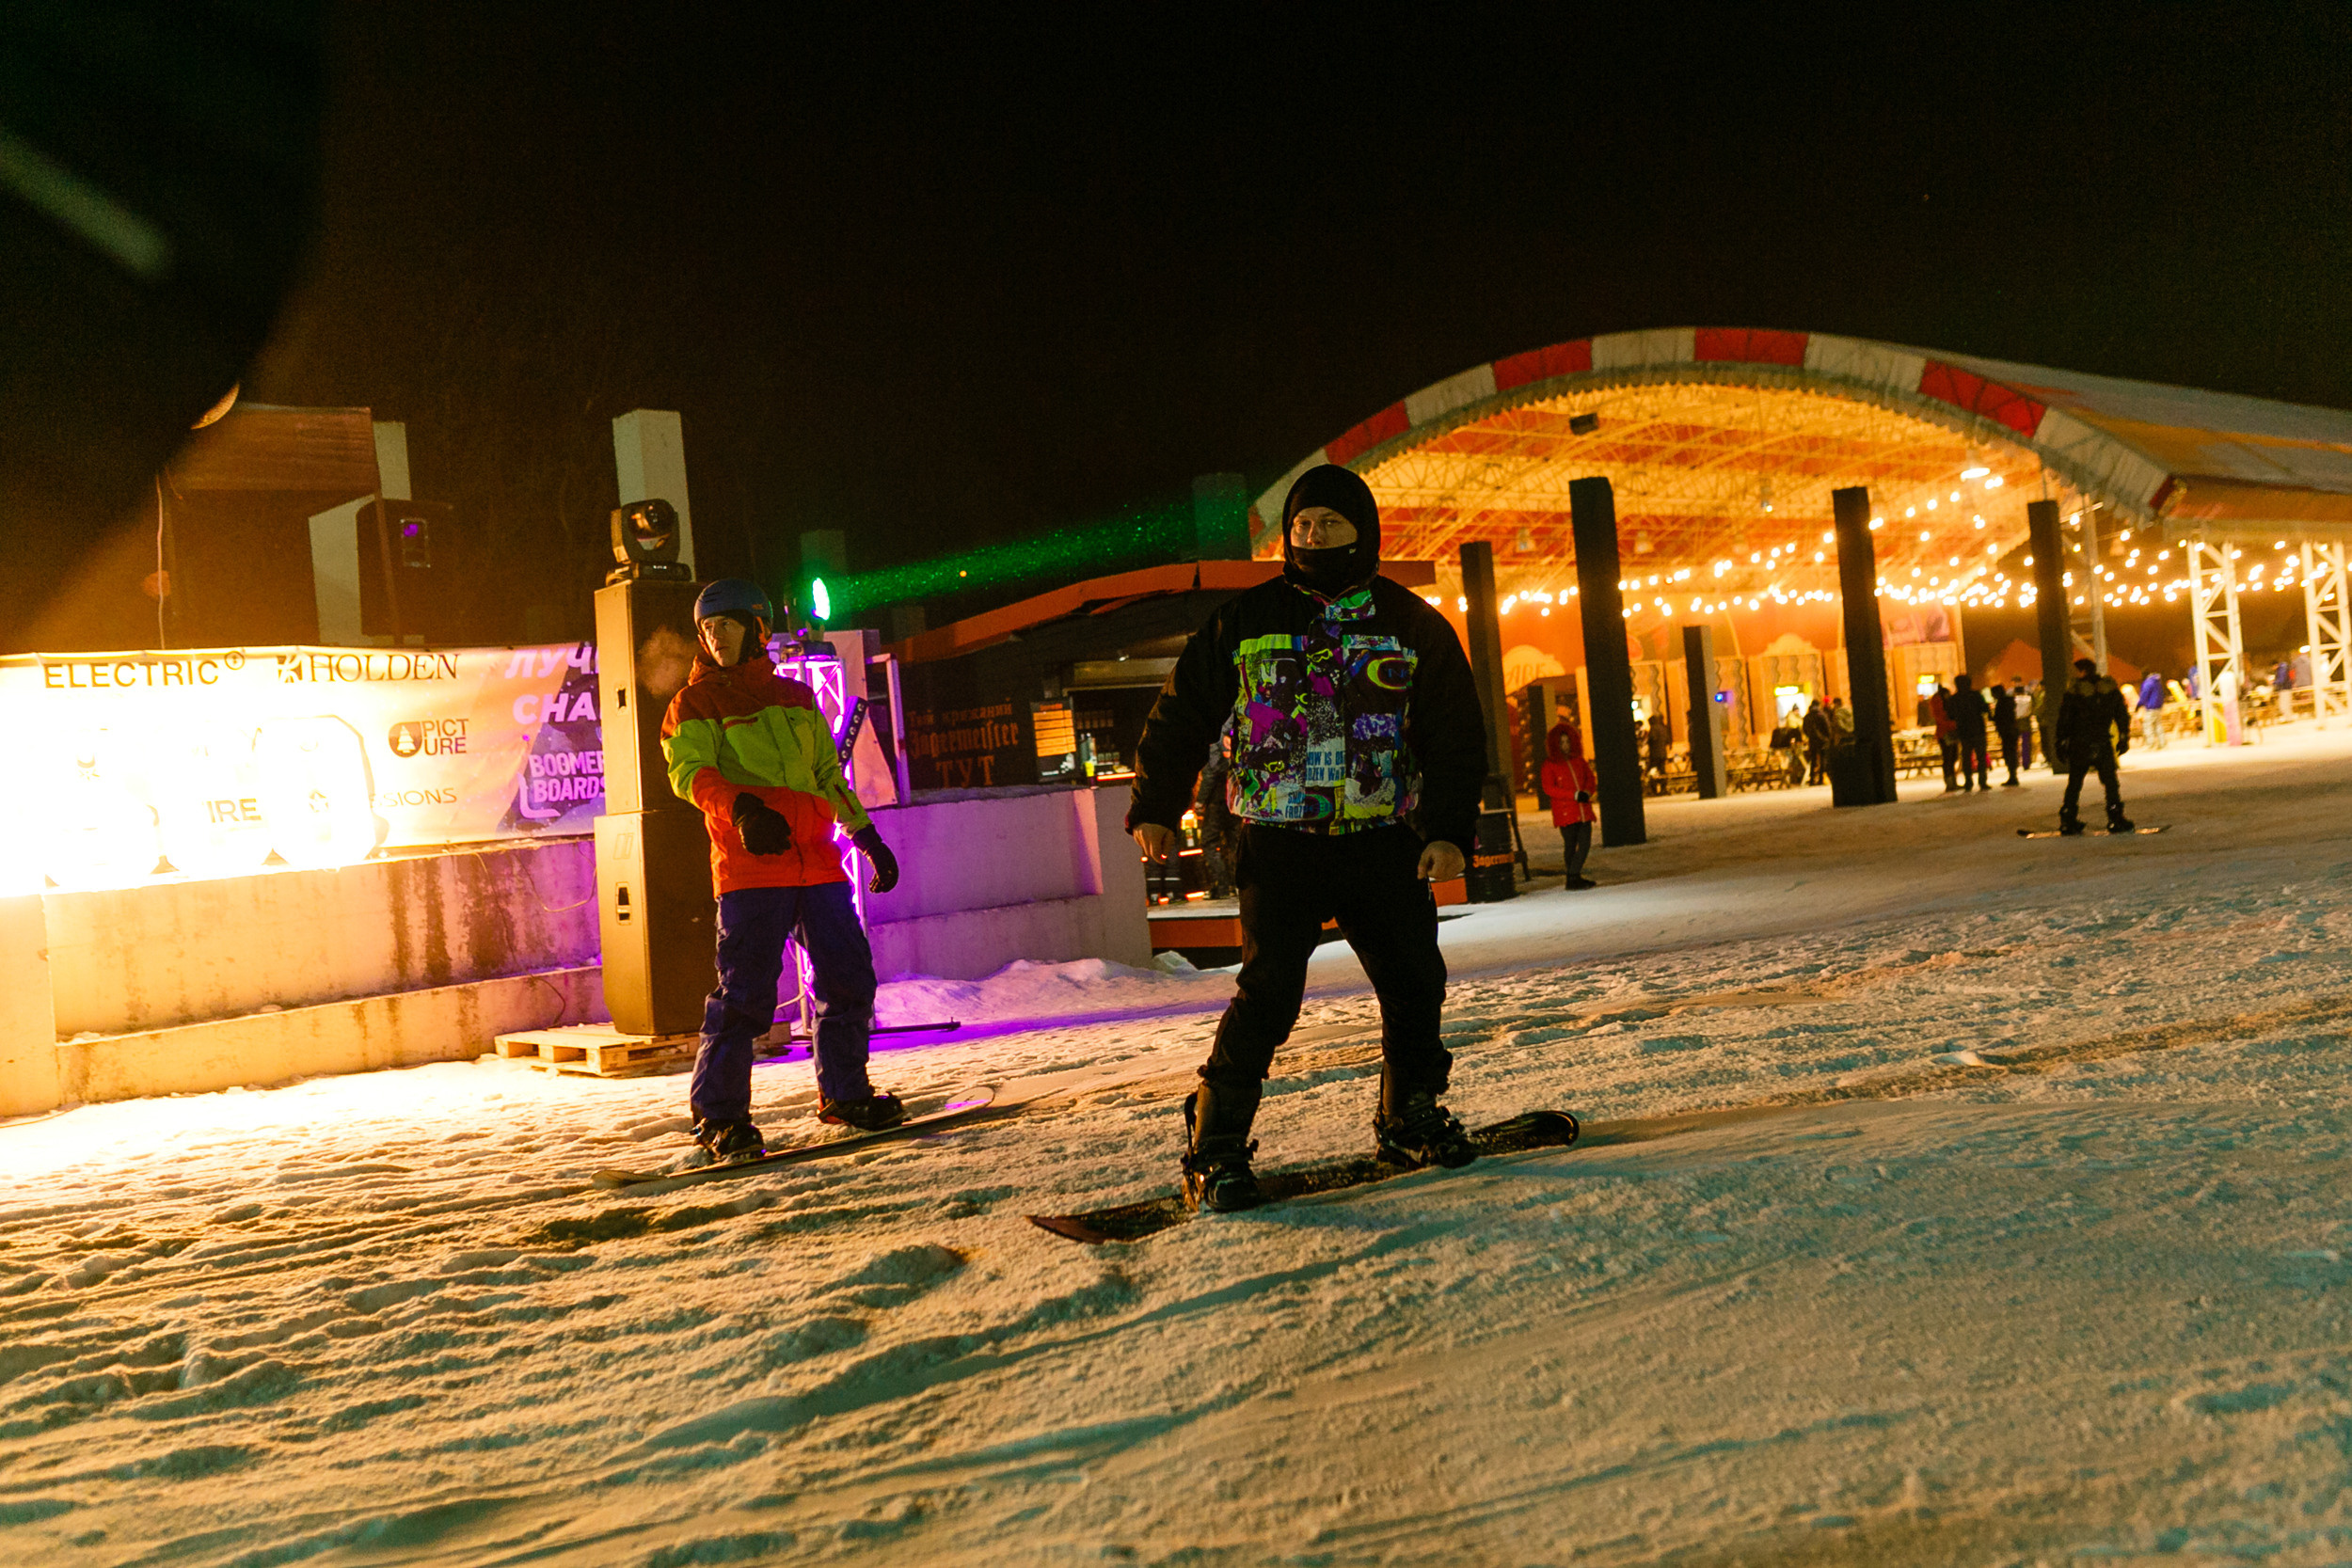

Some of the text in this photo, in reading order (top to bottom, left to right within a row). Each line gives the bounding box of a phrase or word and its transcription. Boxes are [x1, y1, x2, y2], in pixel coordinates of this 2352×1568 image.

[43, 660, 219, 689] ELECTRIC
[309, 654, 462, 683] HOLDEN
[504, 646, 599, 679] ЛУЧ
[513, 691, 601, 725] СНА
[421, 718, 469, 737] PICT
[424, 736, 467, 756] URE
[201, 798, 262, 824] IRE
[371, 787, 457, 808] SIONS
